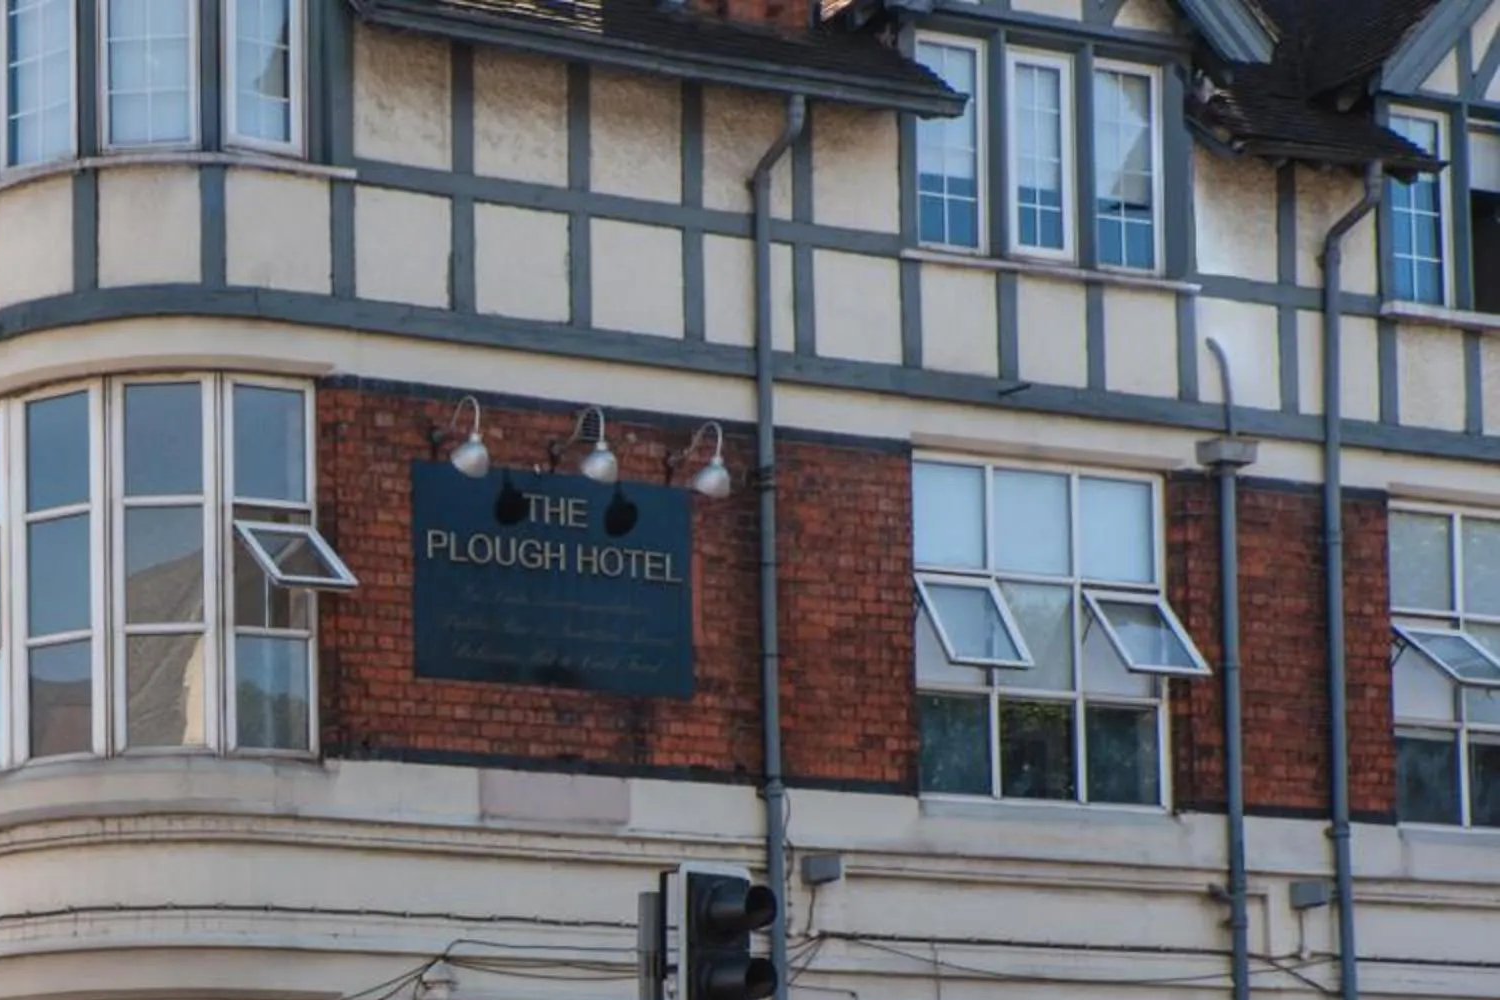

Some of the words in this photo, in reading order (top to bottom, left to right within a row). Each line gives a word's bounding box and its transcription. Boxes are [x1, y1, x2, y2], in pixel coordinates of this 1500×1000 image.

[522, 492, 588, 528] THE
[426, 529, 566, 571] PLOUGH
[576, 544, 683, 582] HOTEL
